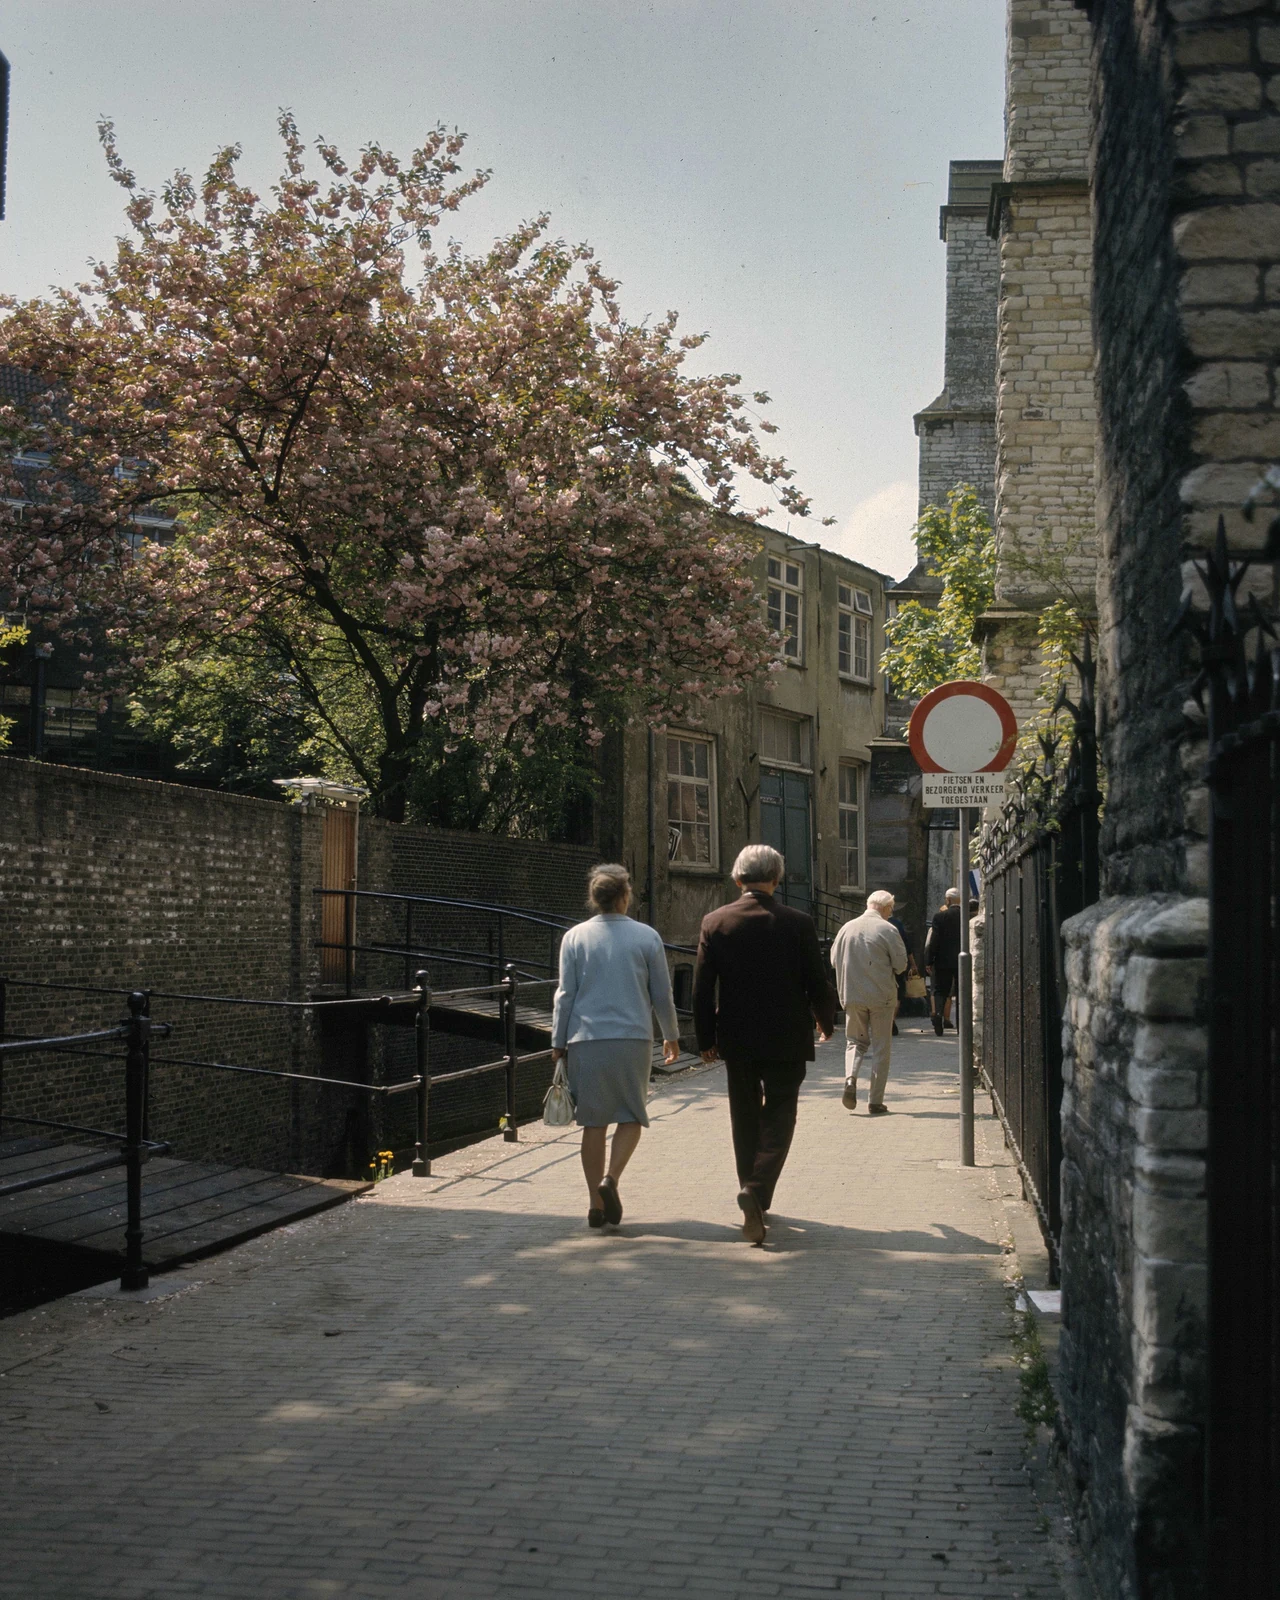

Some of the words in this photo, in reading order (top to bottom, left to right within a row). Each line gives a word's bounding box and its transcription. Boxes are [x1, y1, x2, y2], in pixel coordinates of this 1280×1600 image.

[943, 776, 972, 784] FIETSEN
[976, 776, 984, 784] EN
[926, 786, 968, 794] BEZORGEND
[971, 785, 1004, 794] VERKEER
[941, 796, 988, 804] TOEGESTAAN
